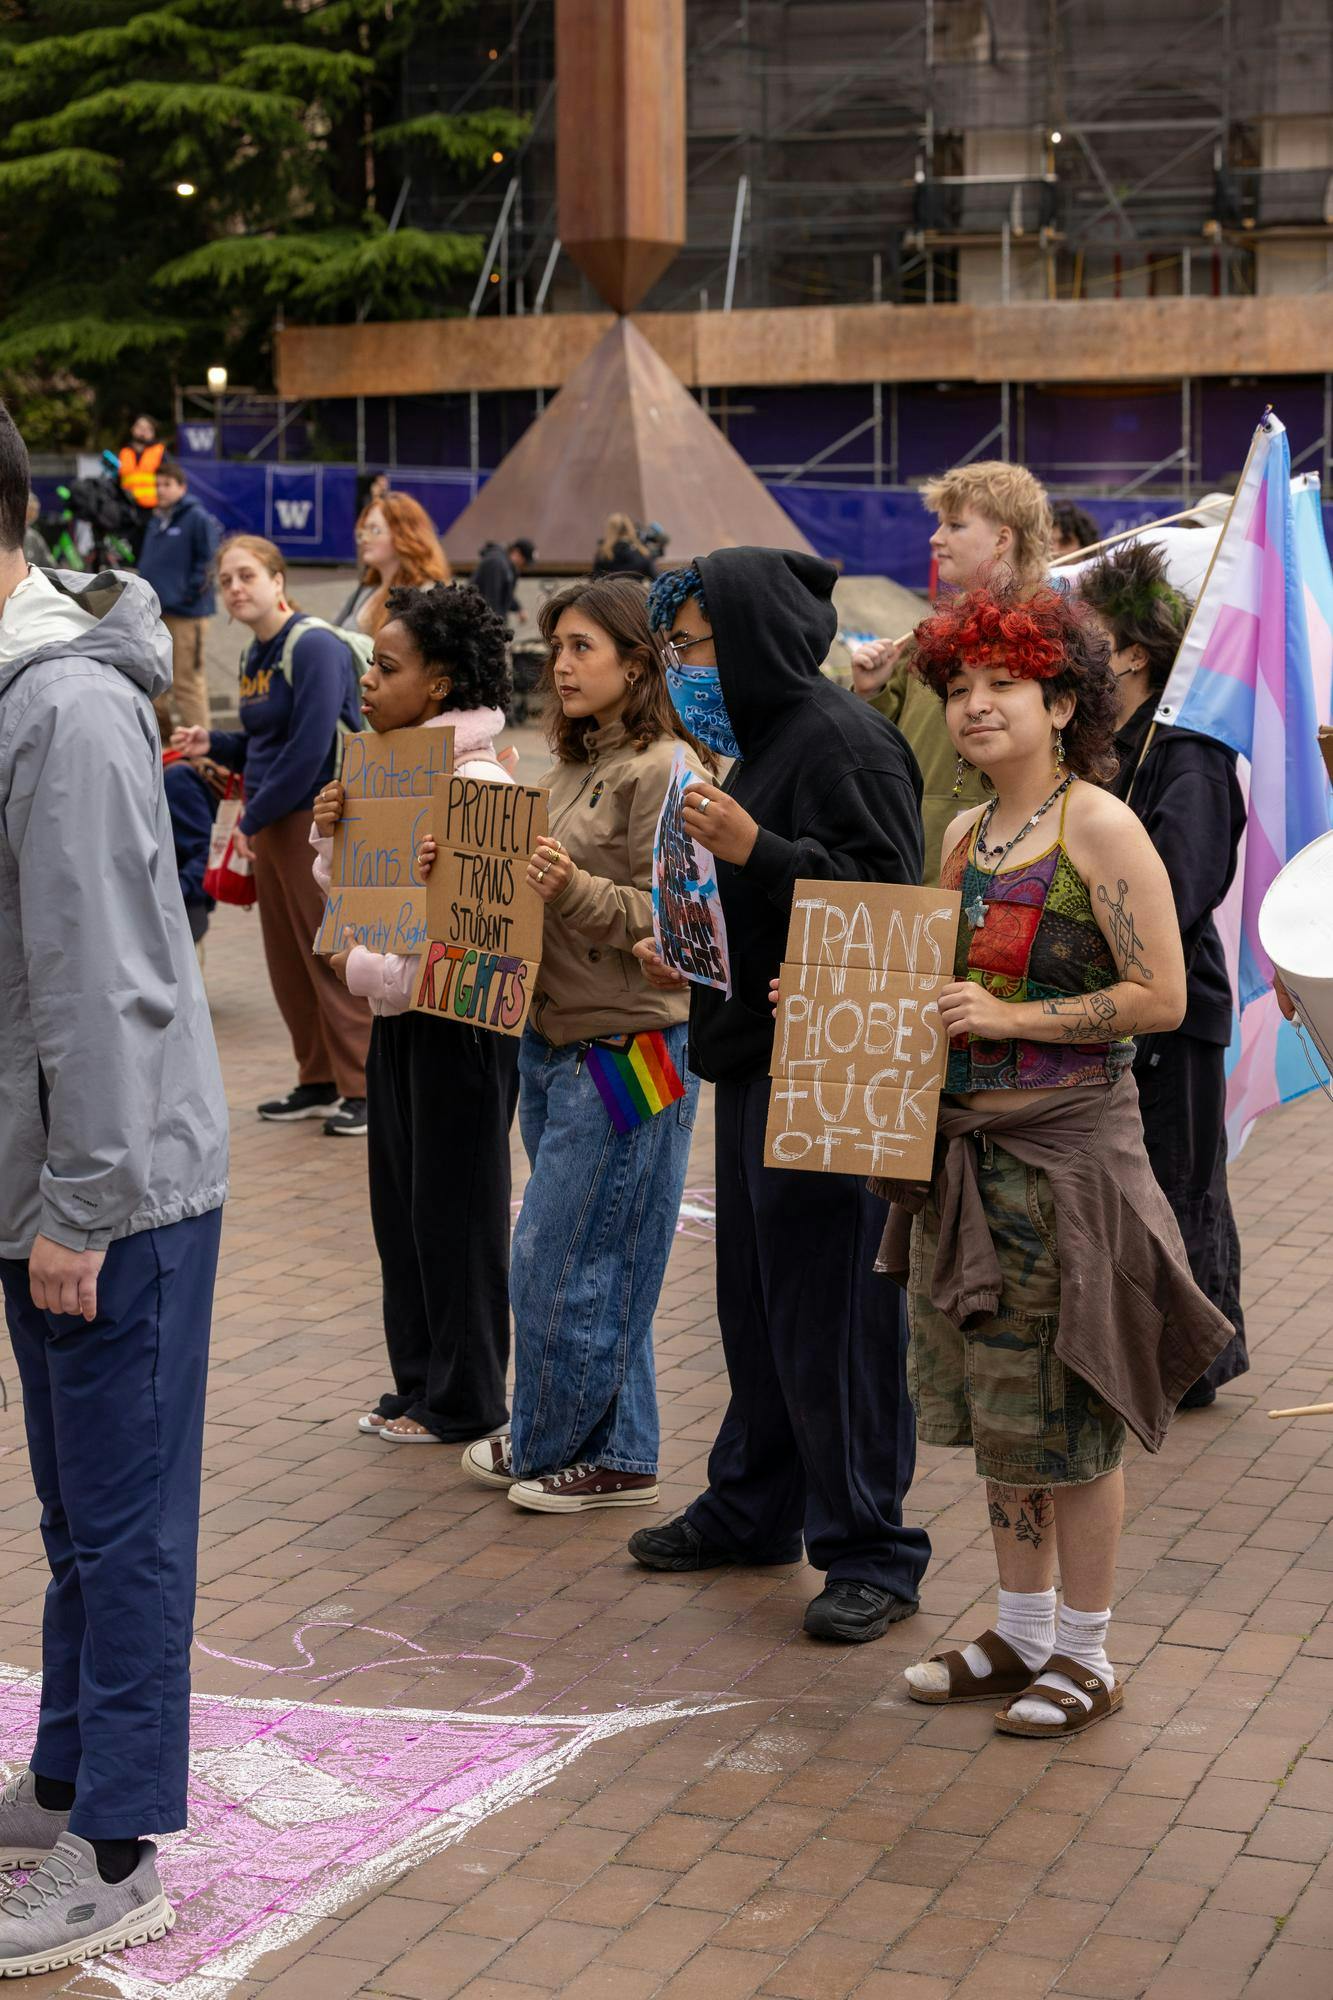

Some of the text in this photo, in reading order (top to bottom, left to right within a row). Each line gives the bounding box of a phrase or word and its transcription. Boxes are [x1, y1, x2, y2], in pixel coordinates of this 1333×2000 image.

[274, 500, 313, 530] W
[336, 817, 401, 888] Trans
[446, 777, 541, 855] PROTECT
[453, 851, 516, 906] TRANS
[449, 902, 514, 953] STUDENT
[794, 897, 953, 998] TRANS
[416, 940, 528, 1030] RIGHTS
[778, 993, 940, 1075] PHOBES
[774, 1057, 942, 1132] FUCK
[771, 1123, 923, 1173] OFF
